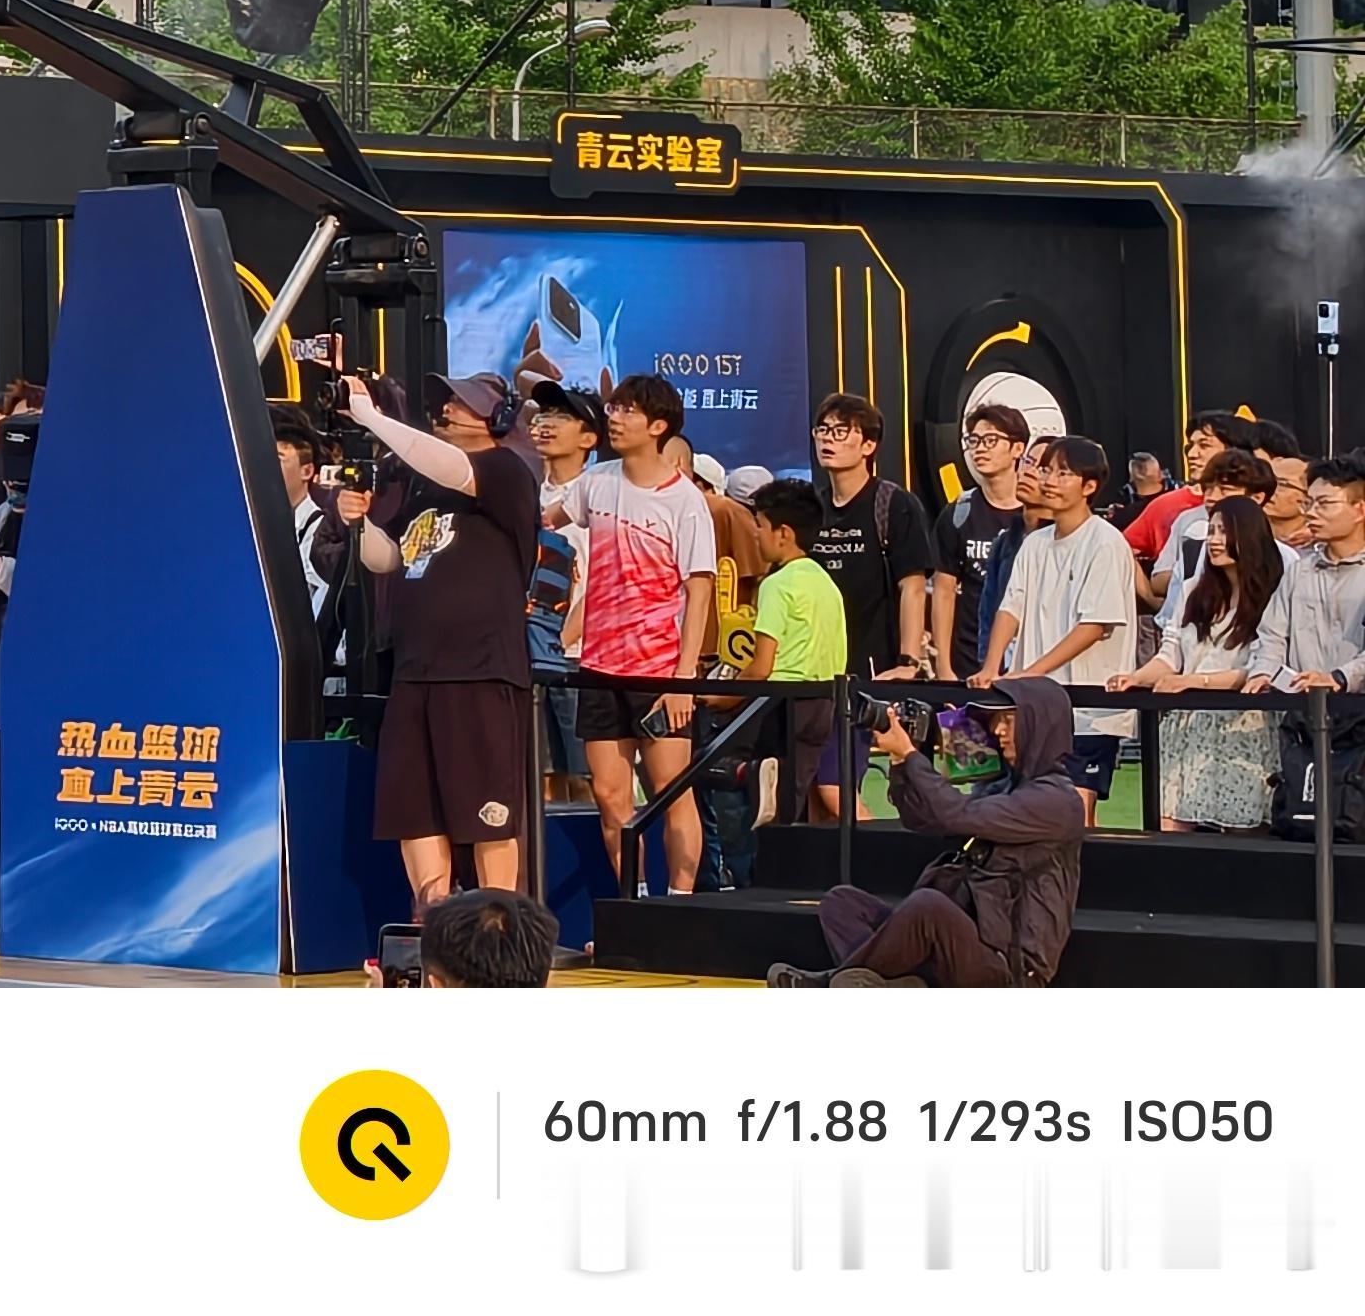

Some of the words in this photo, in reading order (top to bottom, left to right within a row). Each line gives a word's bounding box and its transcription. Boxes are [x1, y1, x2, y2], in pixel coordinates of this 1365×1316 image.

[576, 131, 723, 174] 青云实验室
[57, 721, 221, 763] 热血篮球
[56, 766, 219, 809] 直上青云
